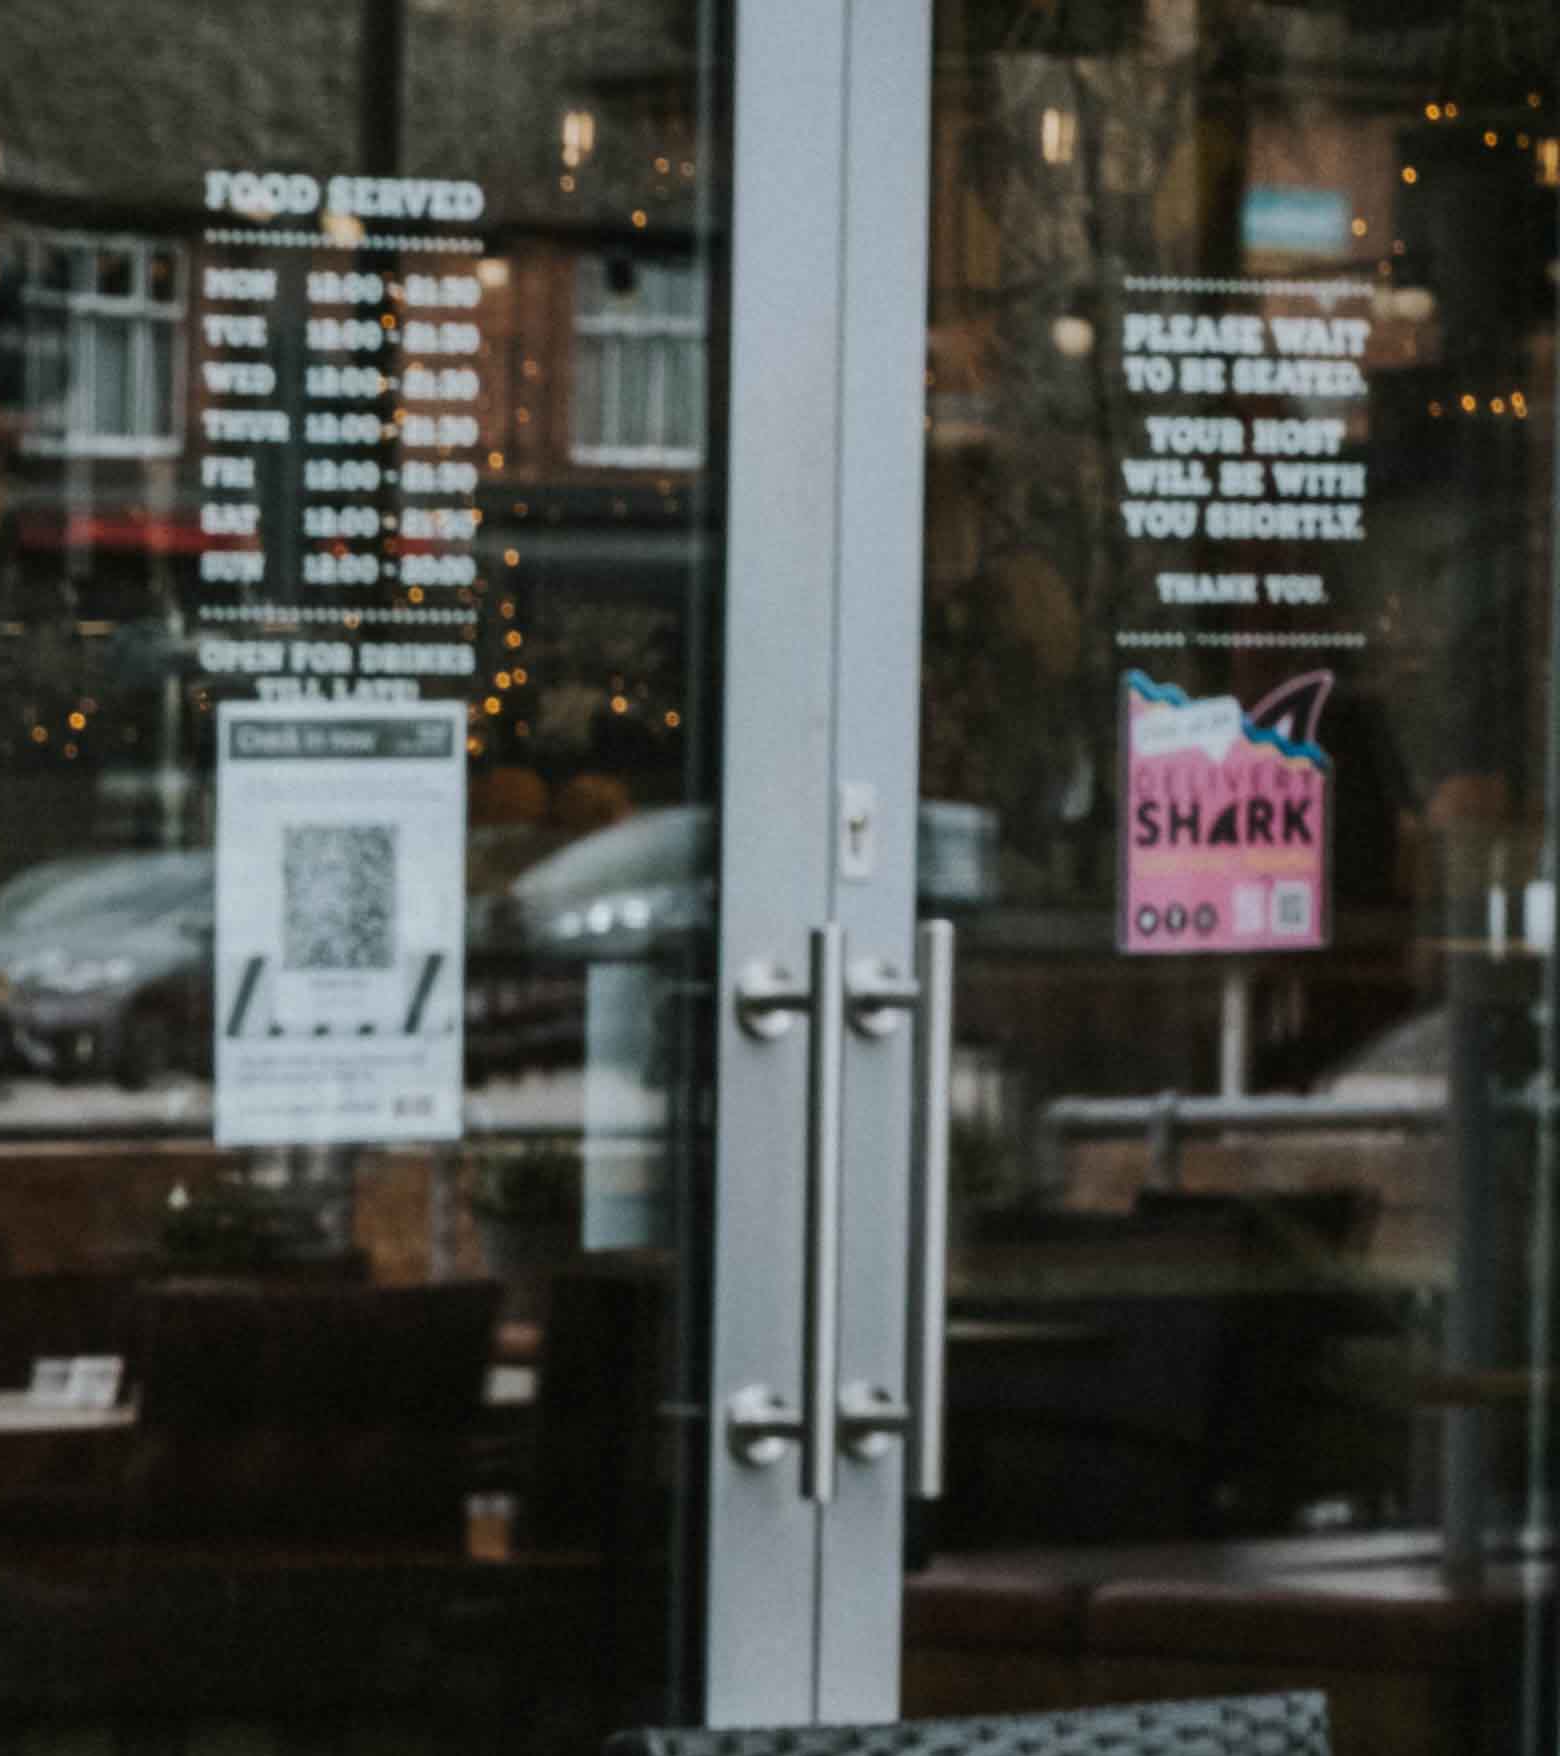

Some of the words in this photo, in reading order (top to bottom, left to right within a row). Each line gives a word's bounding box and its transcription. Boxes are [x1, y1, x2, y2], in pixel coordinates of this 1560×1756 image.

[204, 171, 319, 214] FOOD
[327, 176, 484, 220] SERVED
[1123, 313, 1264, 353] PLEASE
[1270, 318, 1370, 355] WAIT
[202, 361, 275, 394] WED
[1123, 357, 1172, 393] TO
[1179, 359, 1226, 394] BE
[1146, 417, 1244, 454] YOUR
[1253, 419, 1346, 455] HOST
[1122, 460, 1211, 496] WILL
[1218, 461, 1264, 497] BE
[1273, 463, 1365, 498] WITH
[1122, 501, 1197, 538] YOU
[1157, 573, 1257, 603] THANK
[200, 641, 283, 671] OPEN
[290, 641, 352, 672] FOR
[1135, 799, 1312, 847] SHARK
